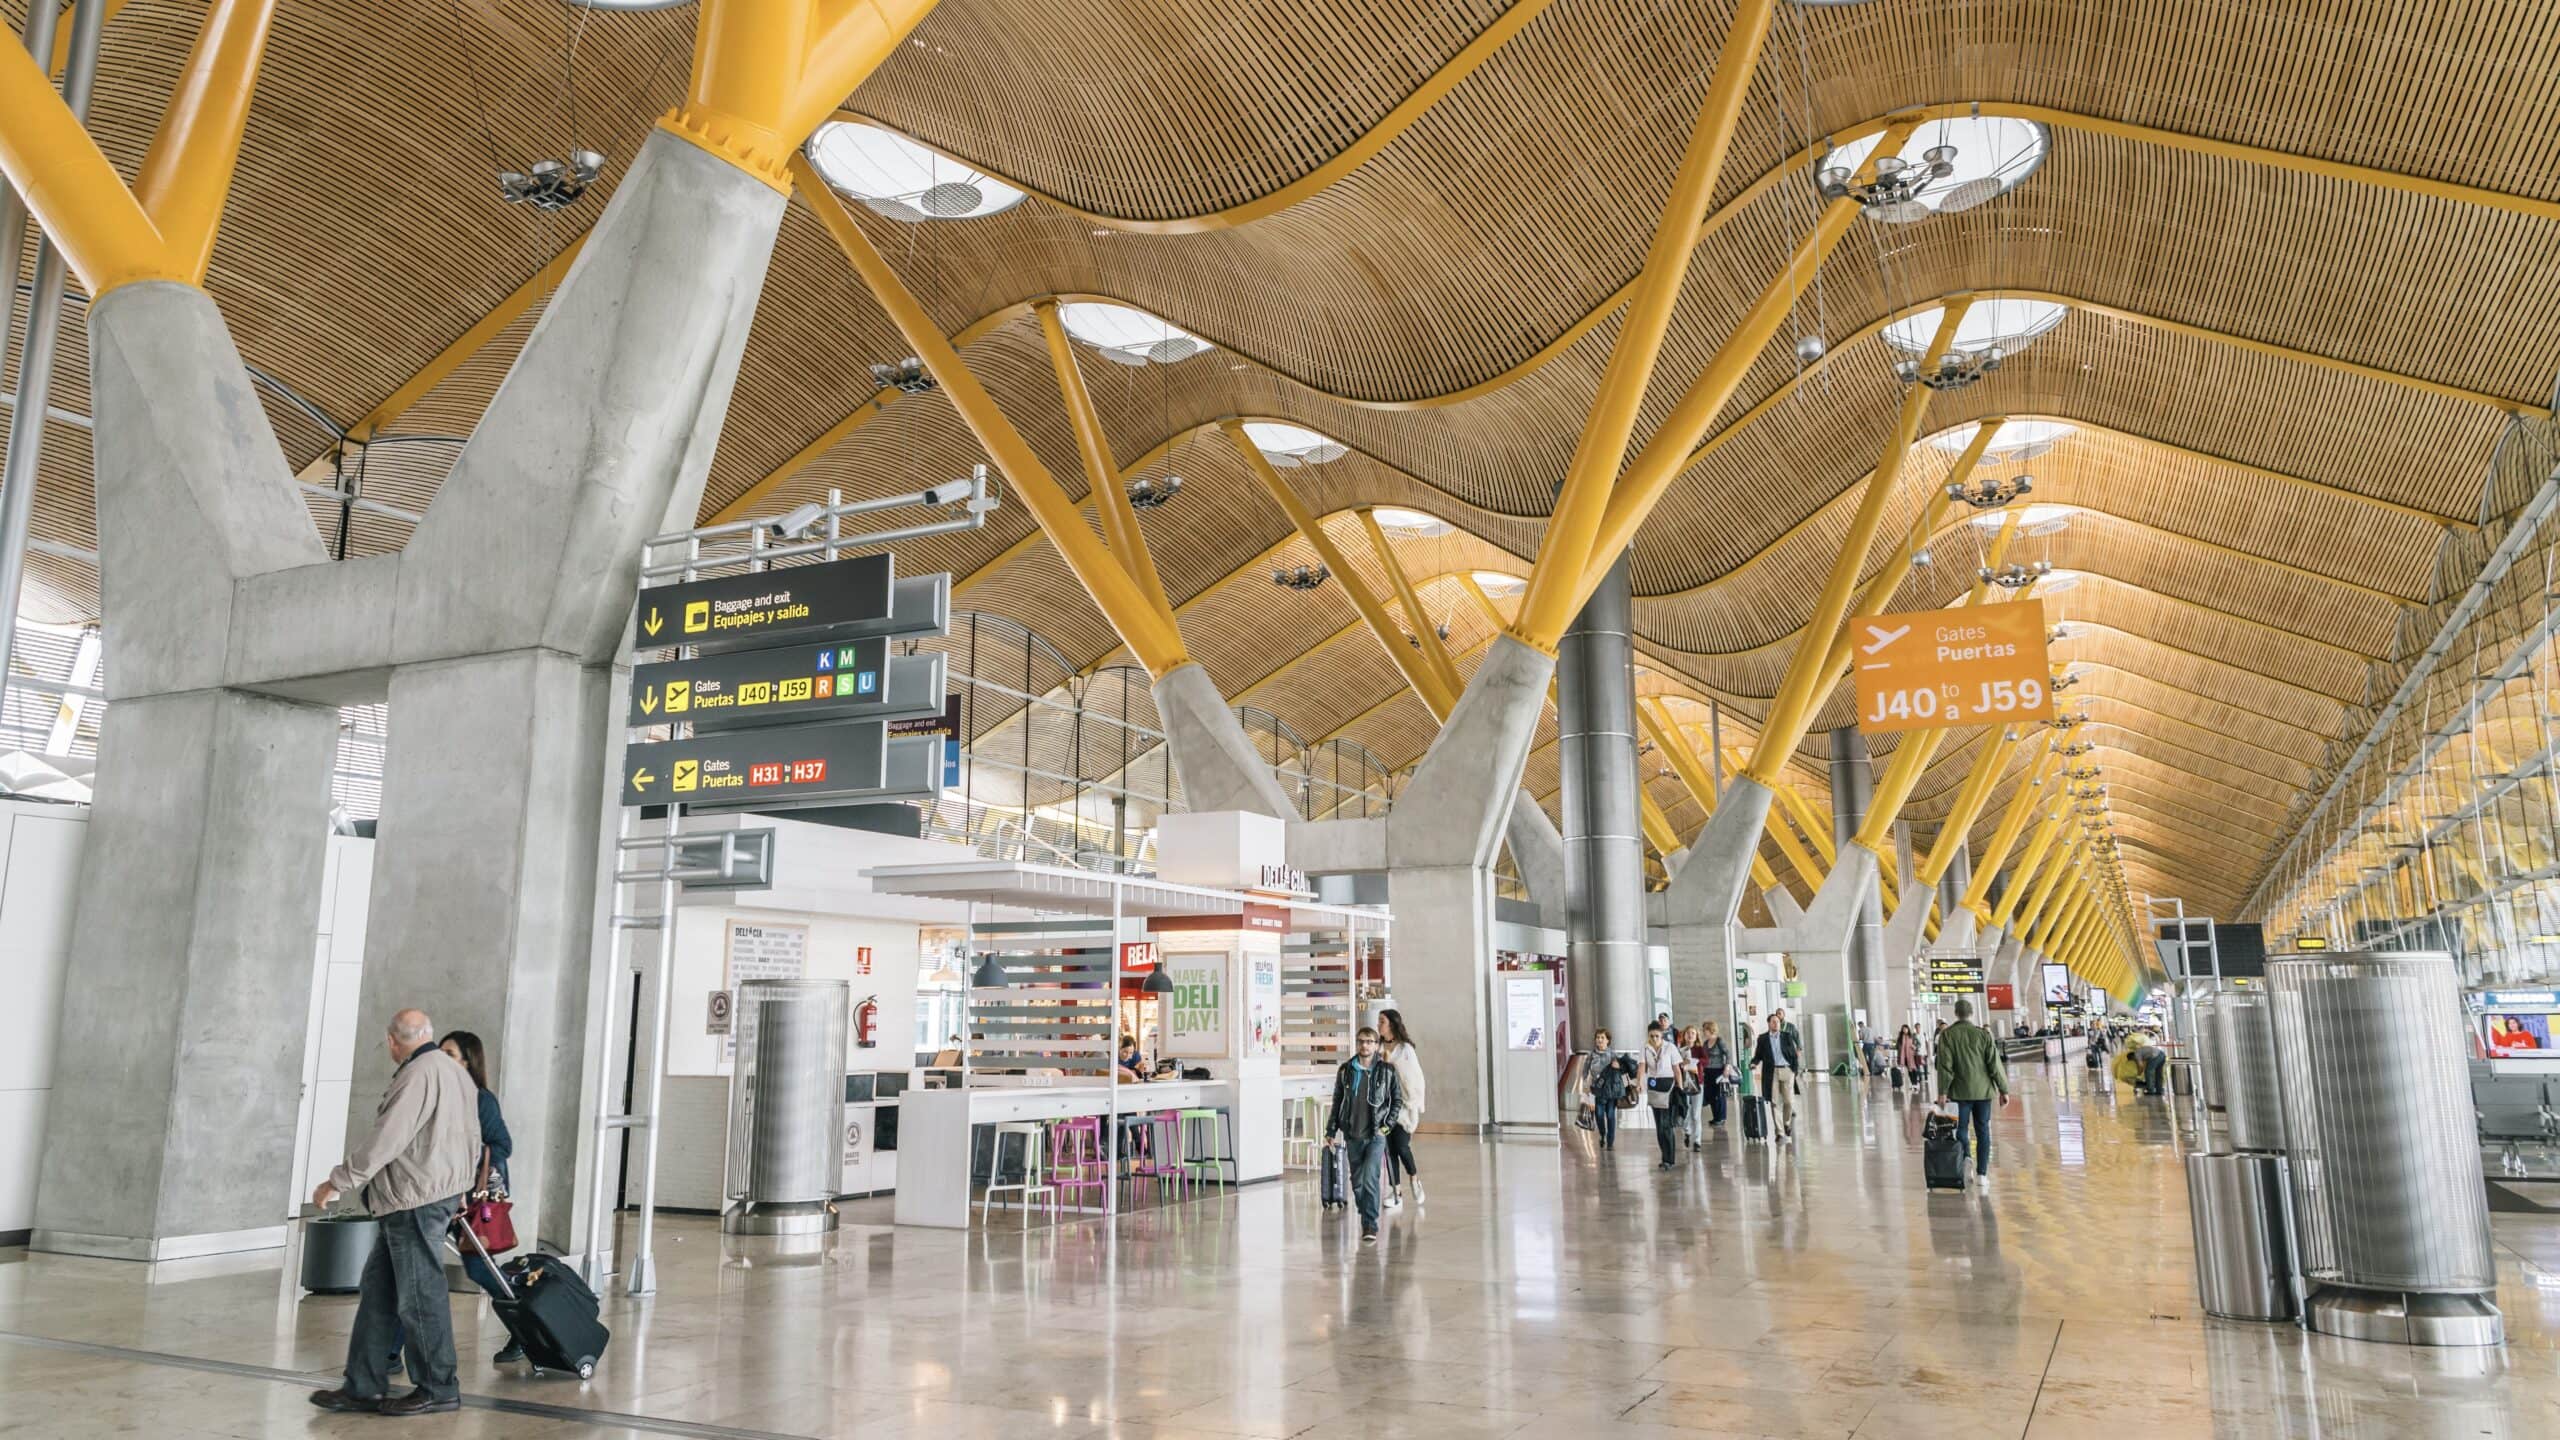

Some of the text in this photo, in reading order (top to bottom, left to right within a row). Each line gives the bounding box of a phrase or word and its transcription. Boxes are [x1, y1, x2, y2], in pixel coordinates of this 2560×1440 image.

[714, 590, 791, 613] Baggage and exit
[714, 603, 809, 629] Equipajes y salida
[1936, 626, 1986, 643] Gates
[820, 649, 853, 669] K M
[1937, 643, 2016, 662] Puertas
[694, 680, 721, 693] Gates
[694, 693, 734, 709] Puertas
[741, 686, 767, 702] J40
[783, 681, 807, 698] J59
[819, 674, 872, 694] R S U
[1868, 678, 2043, 723] J40 to a J59
[702, 774, 744, 788] Puertas
[752, 766, 779, 783] H31
[794, 763, 823, 780] H37
[703, 759, 730, 772] Gates
[1127, 942, 1159, 967] RELA
[1173, 968, 1219, 983] HAVE A
[1173, 984, 1219, 1009] DELI
[1173, 1010, 1219, 1032] DAY!
